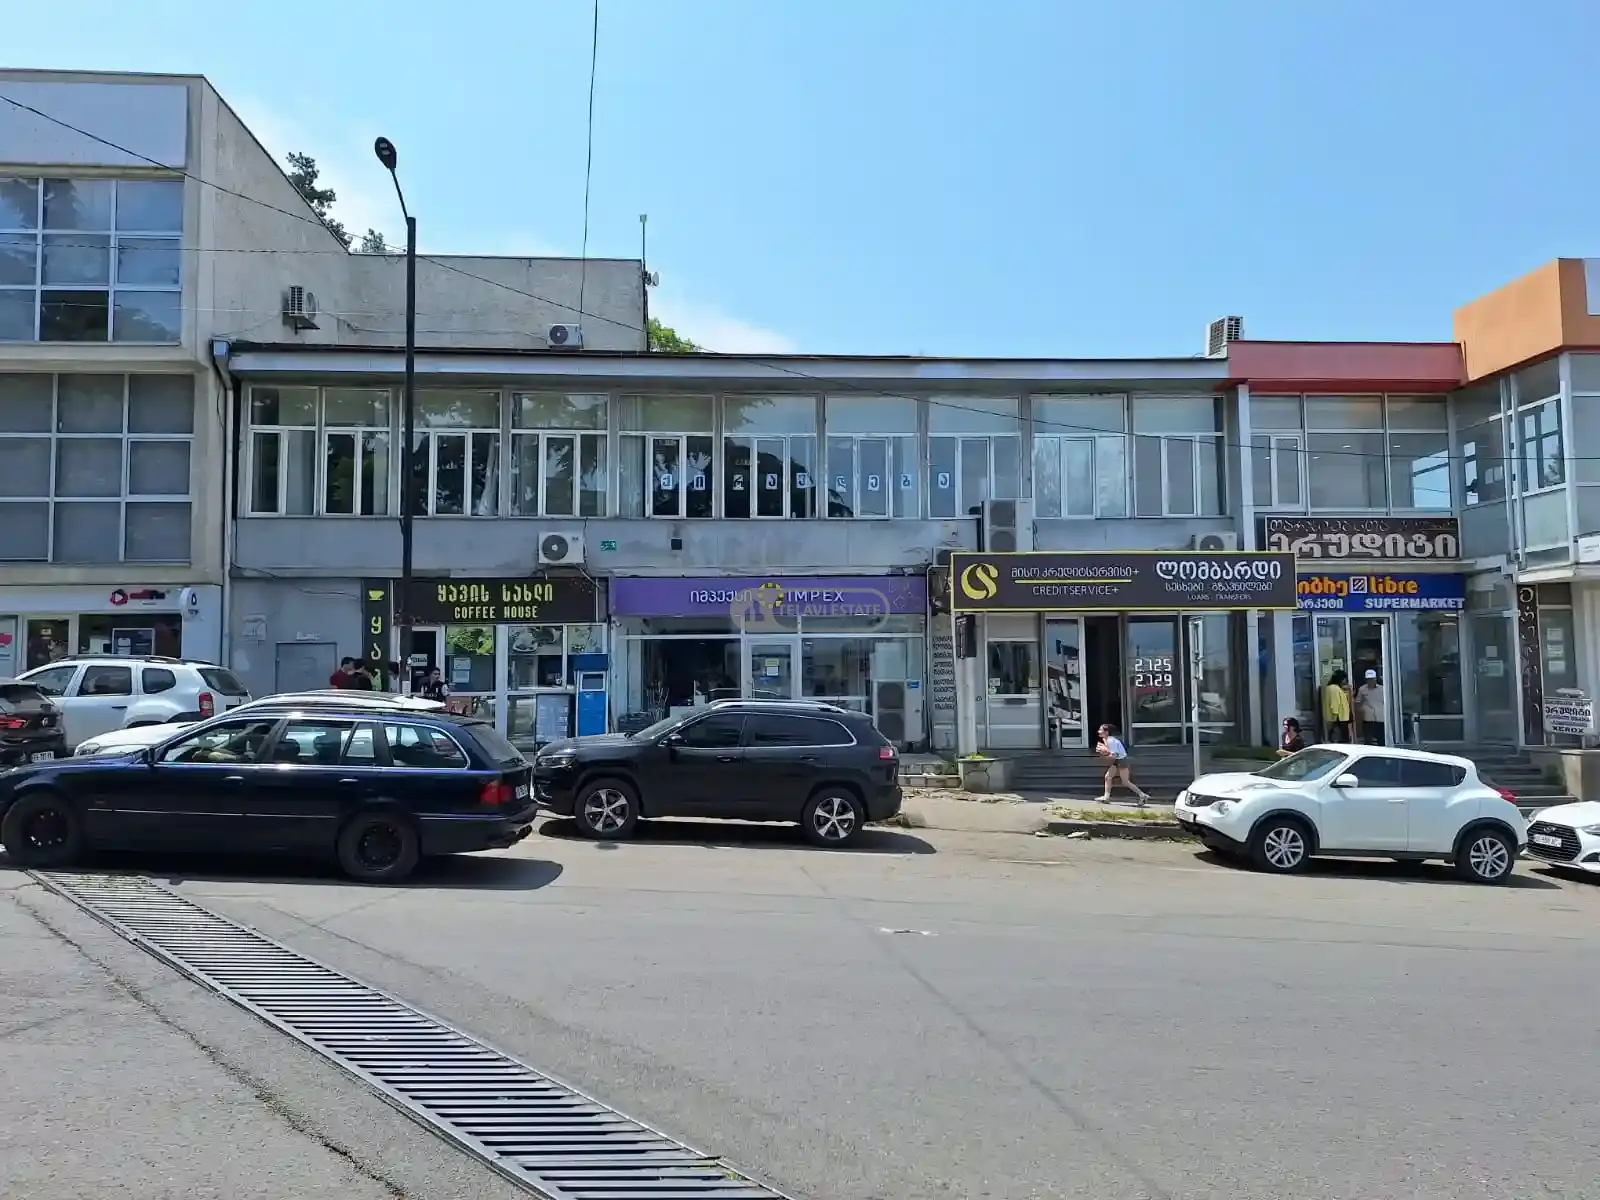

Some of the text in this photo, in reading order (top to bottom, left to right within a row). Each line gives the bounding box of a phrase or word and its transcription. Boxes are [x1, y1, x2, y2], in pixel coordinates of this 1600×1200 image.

[1155, 560, 1281, 580] ლომბარდი
[1165, 581, 1204, 592] სესხები
[1369, 576, 1418, 595] libre
[437, 583, 553, 603] ყავის სახლი
[787, 589, 845, 602] IMPEX
[1364, 597, 1465, 609] SUPERMARKET
[454, 605, 539, 619] COFFEE HOUSE
